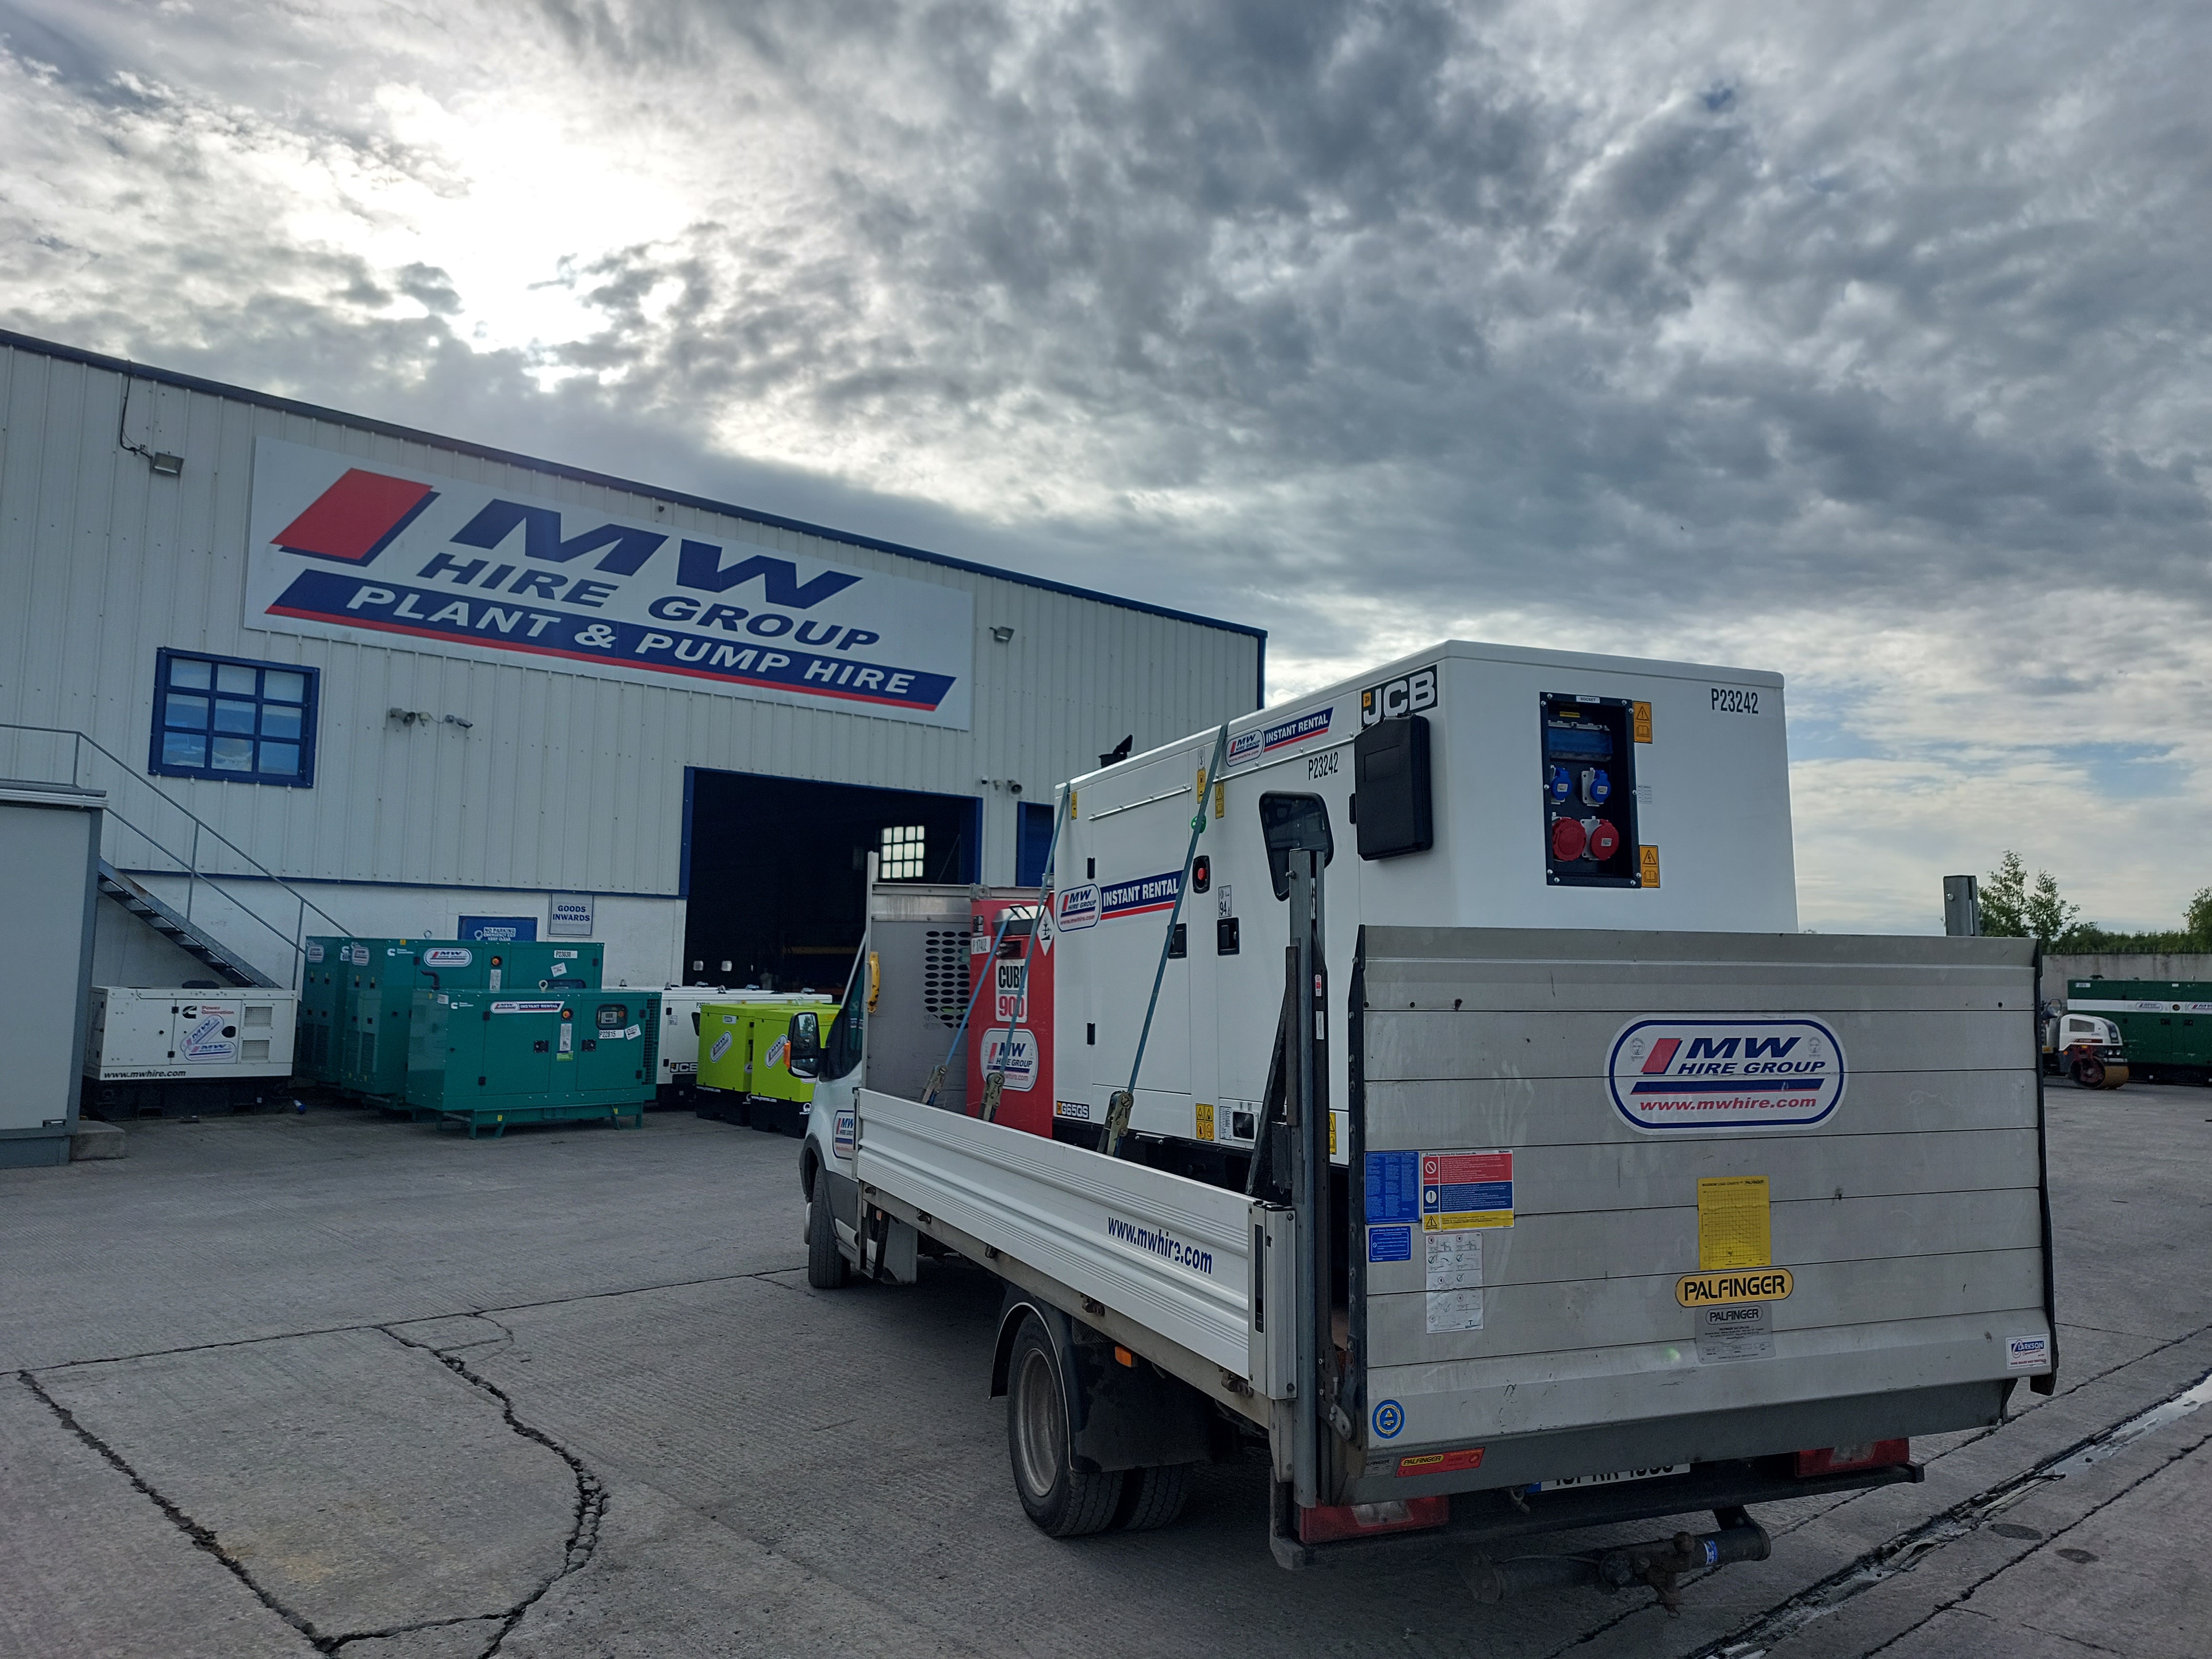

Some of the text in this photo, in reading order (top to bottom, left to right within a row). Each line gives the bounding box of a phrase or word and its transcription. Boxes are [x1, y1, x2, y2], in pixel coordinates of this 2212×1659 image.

[449, 498, 863, 610] MW
[416, 553, 880, 651] HIRE GROUP
[346, 586, 916, 695] PLANT & PUMP HIRE
[1363, 671, 1435, 724] JCB
[1711, 688, 1759, 714] P23242
[1266, 714, 1328, 743] INSTANT RENTAL
[1237, 734, 1256, 746] MW
[1308, 751, 1338, 781] P23242
[1069, 889, 1092, 904] MW
[1103, 878, 1179, 907] INSTANT RENTAL
[1068, 899, 1096, 911] HIRE GROUP
[1220, 900, 1227, 916] 94
[1685, 1037, 1802, 1059] MW
[1012, 1059, 1033, 1068] GROUP
[1677, 1061, 1826, 1074] HIRE GROUP
[104, 1070, 186, 1079] www.mwhire.com
[1062, 1103, 1088, 1118] G65QS
[1640, 1097, 1817, 1111] www.mwhire.com
[1684, 1275, 1785, 1301] PALFINGER
[1710, 1308, 1759, 1322] PALFINGER
[2013, 1339, 2043, 1358] CLARKSON
[1403, 1456, 1442, 1465] PALFINGER
